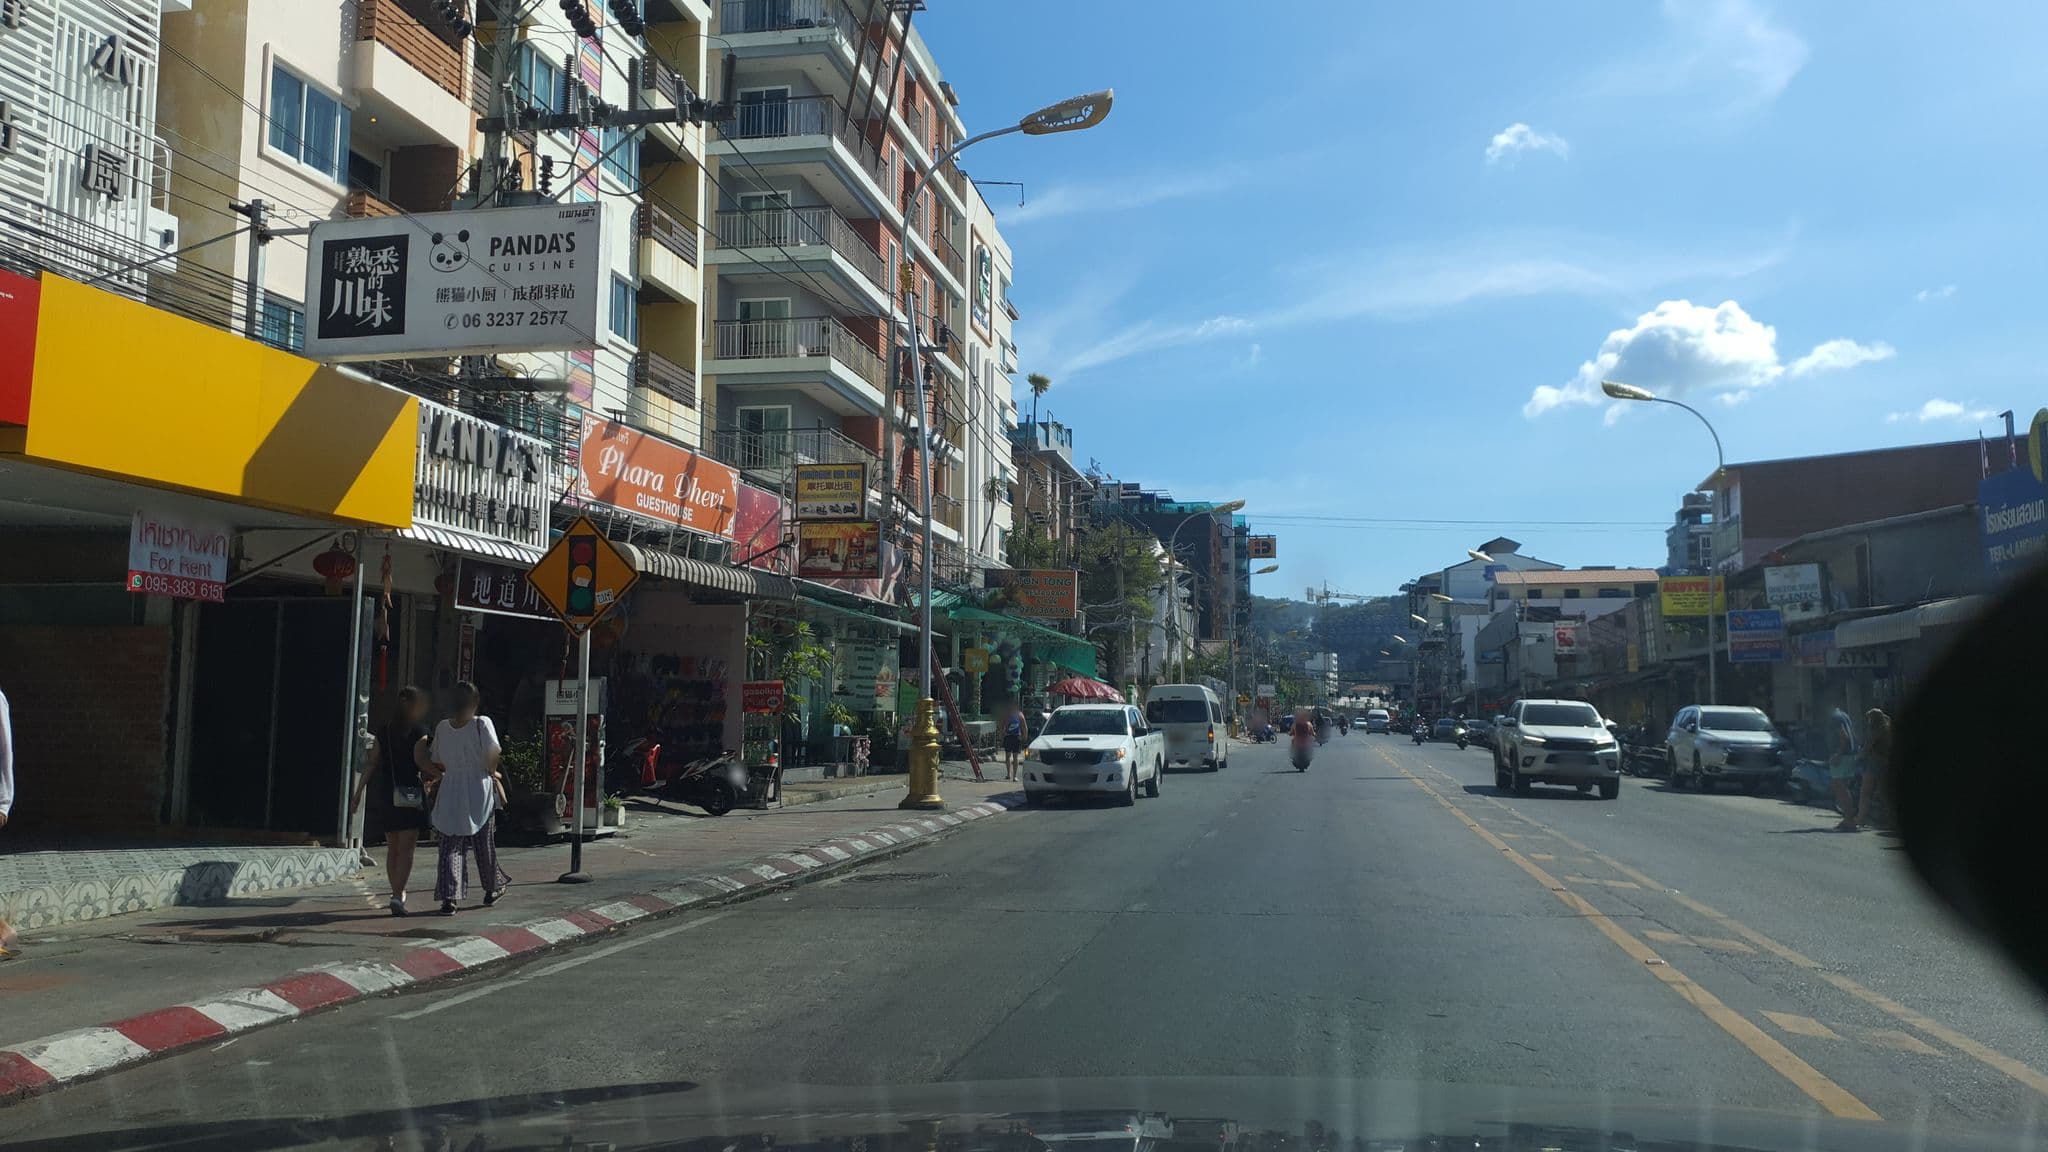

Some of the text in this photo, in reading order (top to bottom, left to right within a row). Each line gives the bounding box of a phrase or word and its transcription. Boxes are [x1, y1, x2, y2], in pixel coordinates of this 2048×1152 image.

[490, 231, 577, 257] PANDA'S
[488, 259, 575, 272] CUISINE
[512, 283, 576, 302] 成都驿站
[462, 310, 569, 328] 06 3237 2577
[598, 444, 727, 513] Phara Dhevi
[636, 492, 694, 521] GUESTHOUSE
[149, 551, 212, 577] For Rent
[144, 575, 223, 600] 095-383 6151
[472, 574, 556, 613] 地道川
[1044, 576, 1072, 587] TONG
[1838, 652, 1877, 665] ATM
